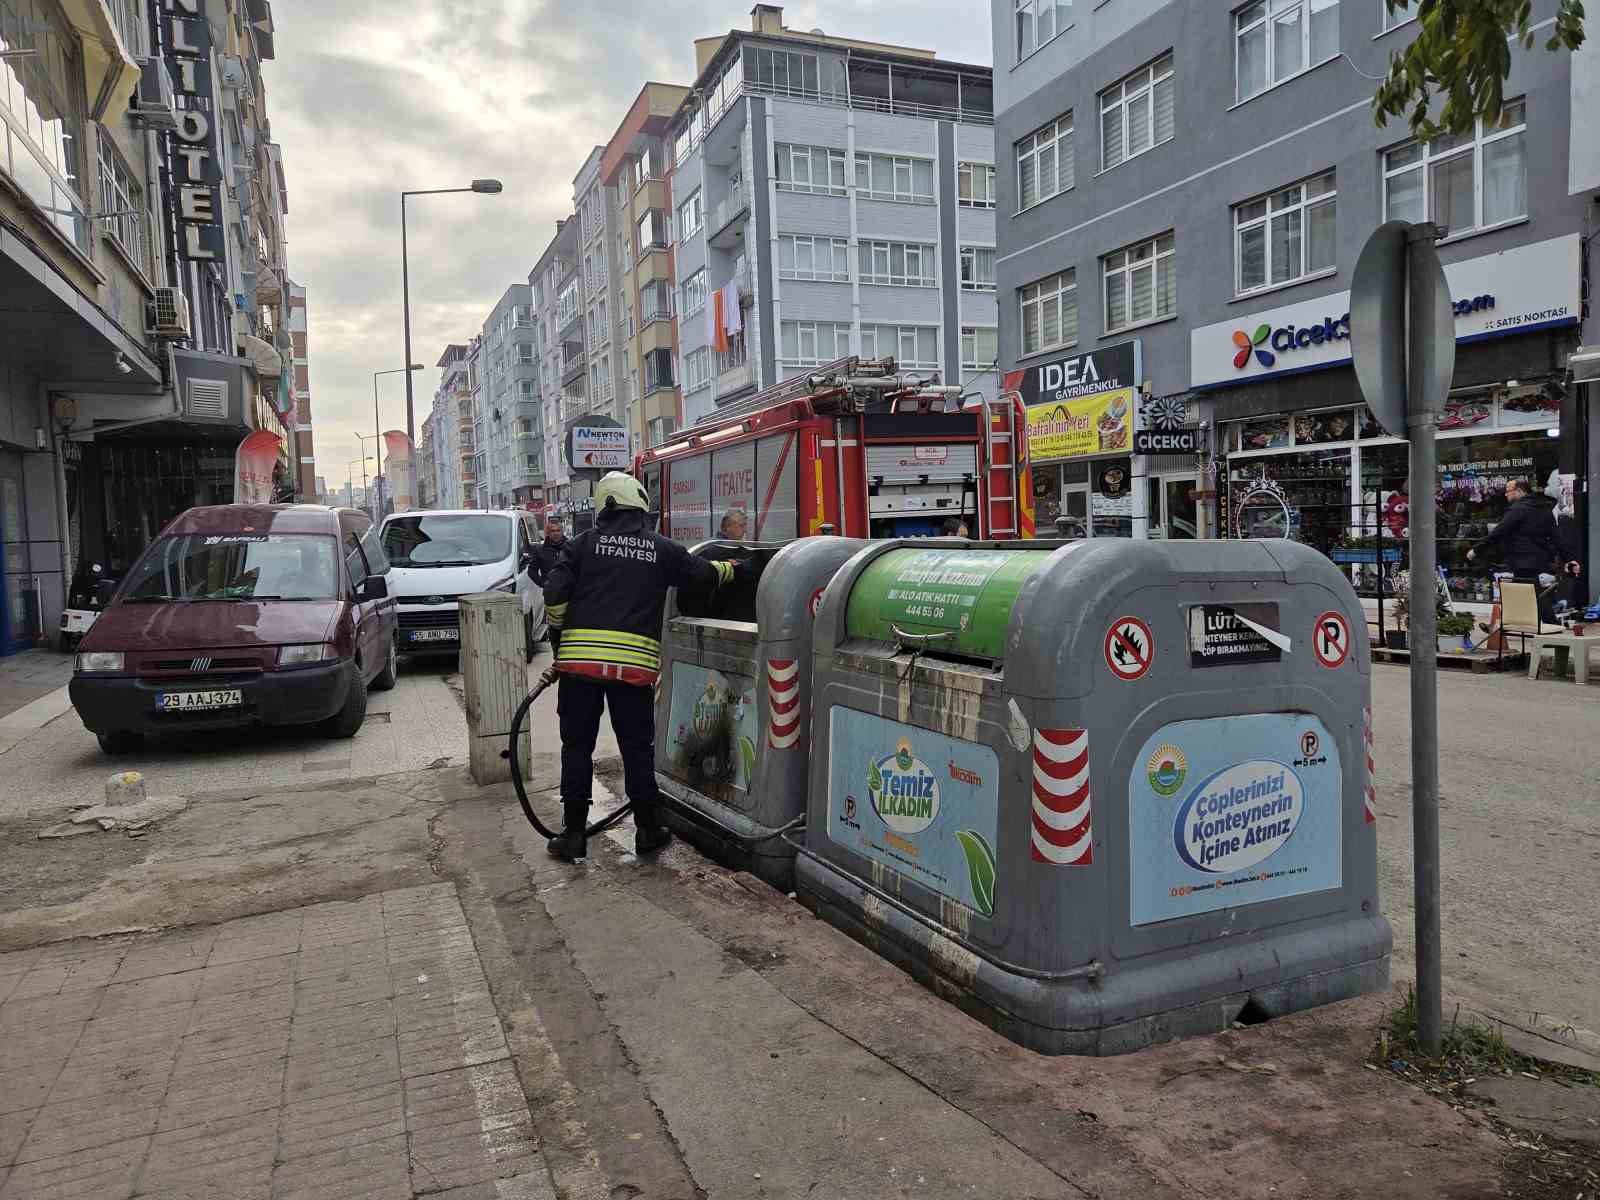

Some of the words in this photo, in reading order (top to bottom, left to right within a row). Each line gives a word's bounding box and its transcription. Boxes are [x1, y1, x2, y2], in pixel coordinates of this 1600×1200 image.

[1039, 355, 1099, 392] IDEA
[599, 535, 655, 551] SAMSUN
[905, 605, 921, 616] 444
[163, 695, 180, 706] 29
[186, 693, 212, 705] AAJ
[214, 692, 239, 703] 374
[881, 770, 934, 797] Temiz
[1196, 771, 1284, 818] Çöplerinizi
[1192, 795, 1293, 843] Konteynerin
[1243, 818, 1291, 848] Atınız
